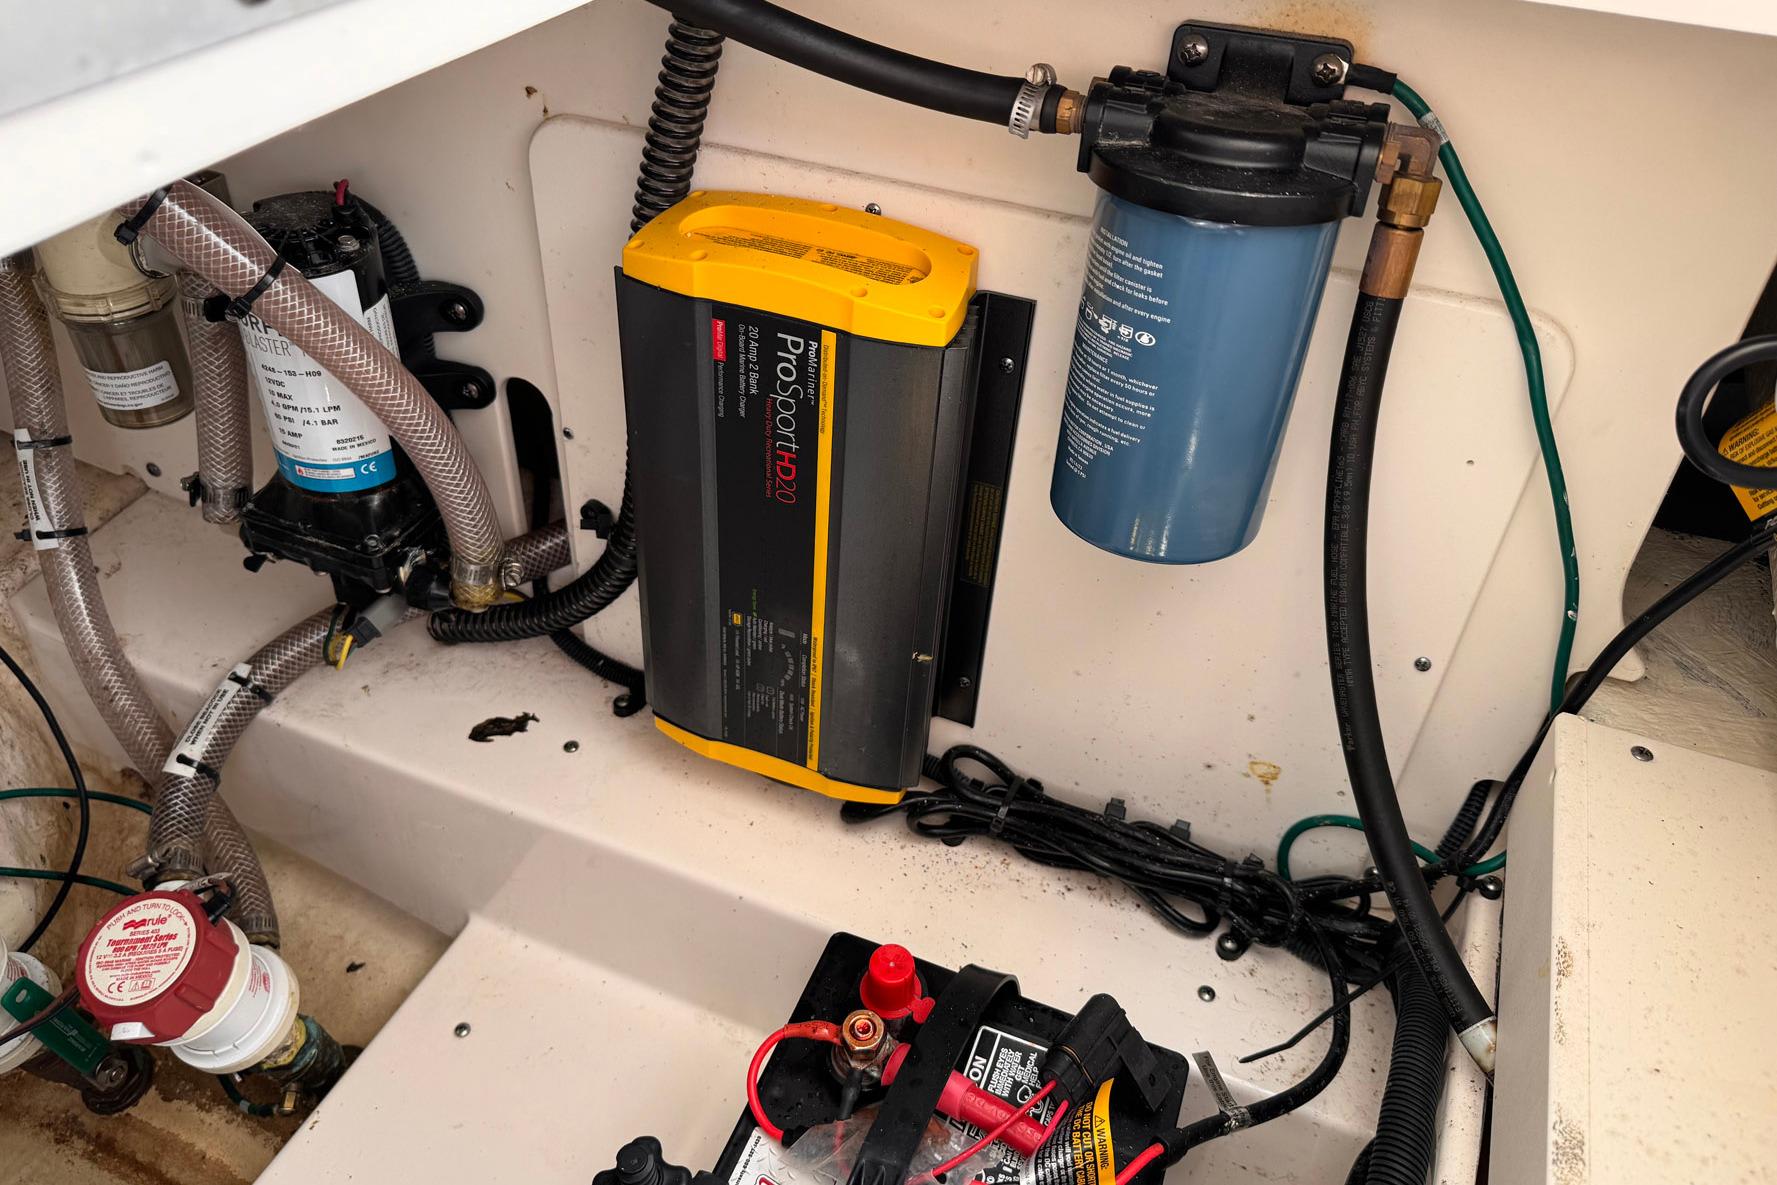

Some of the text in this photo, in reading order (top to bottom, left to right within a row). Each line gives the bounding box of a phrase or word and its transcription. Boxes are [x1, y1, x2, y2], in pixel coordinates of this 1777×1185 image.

[154, 933, 178, 942] Series
[987, 1048, 1008, 1092] FLUSH EYES
[1002, 1051, 1022, 1097] WITH WATER
[1015, 1065, 1025, 1081] GET
[1022, 1052, 1038, 1084] MEDICAL
[1029, 1066, 1039, 1086] HELP
[1082, 1113, 1091, 1127] NOT
[1072, 1132, 1084, 1169] BATTERY
[1082, 1132, 1092, 1150] CUT
[1084, 1151, 1094, 1164] OR
